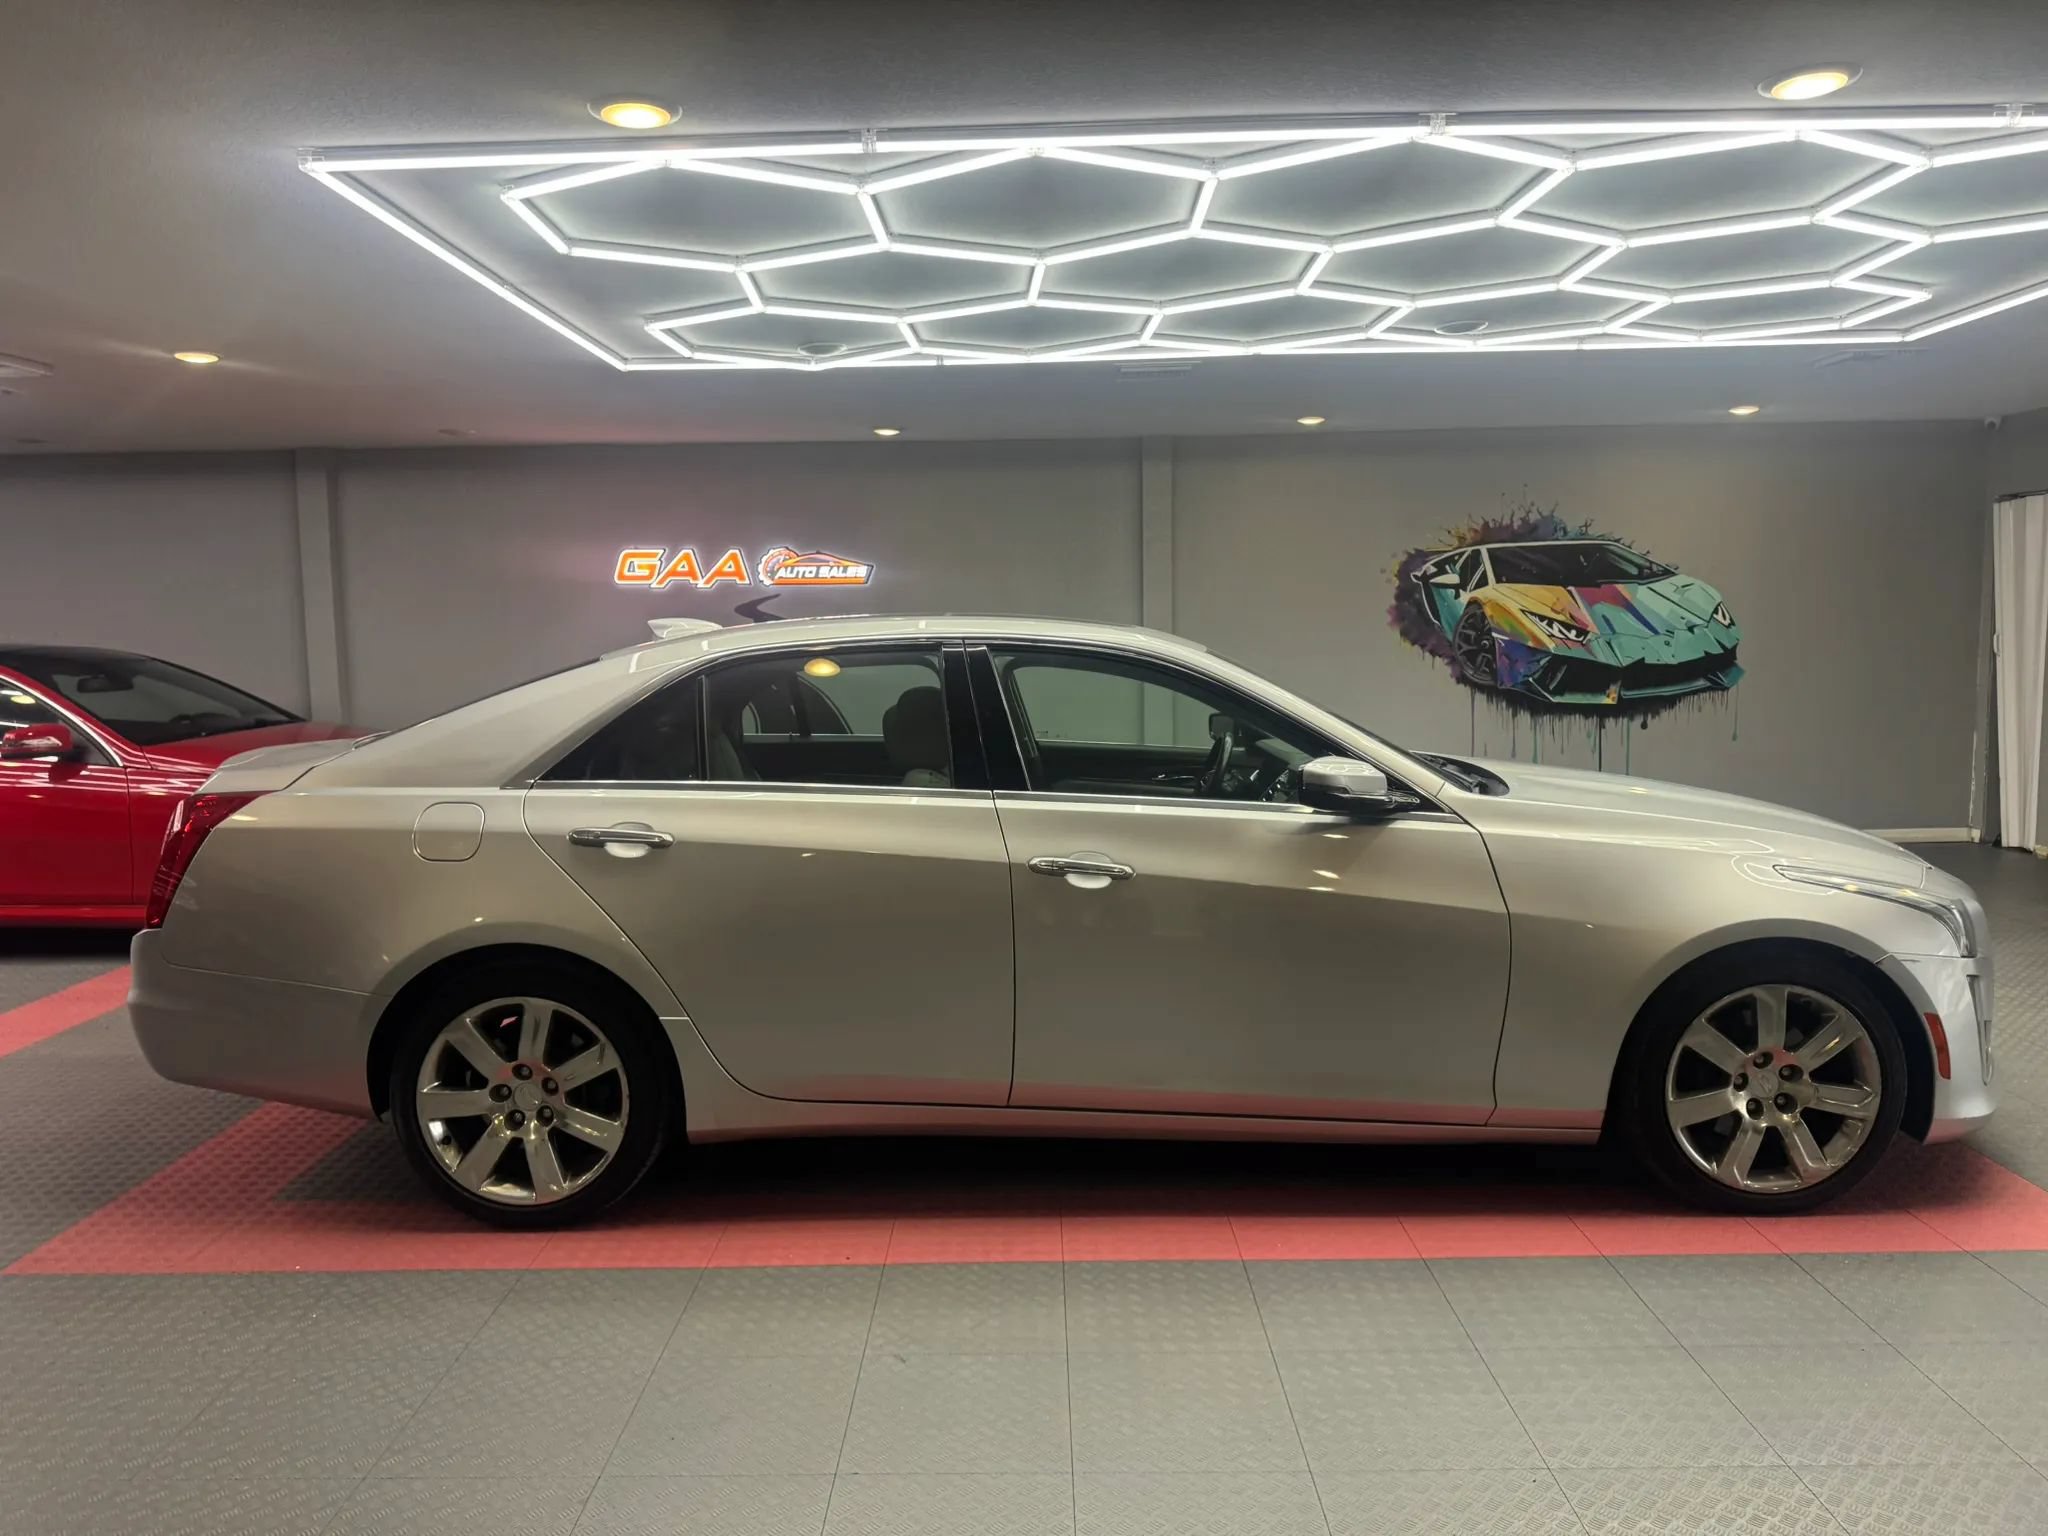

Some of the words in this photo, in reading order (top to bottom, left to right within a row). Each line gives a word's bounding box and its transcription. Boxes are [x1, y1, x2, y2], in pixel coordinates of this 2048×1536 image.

[614, 549, 750, 587] GAA
[775, 566, 816, 579] AUTO
[818, 565, 868, 579] SALES
